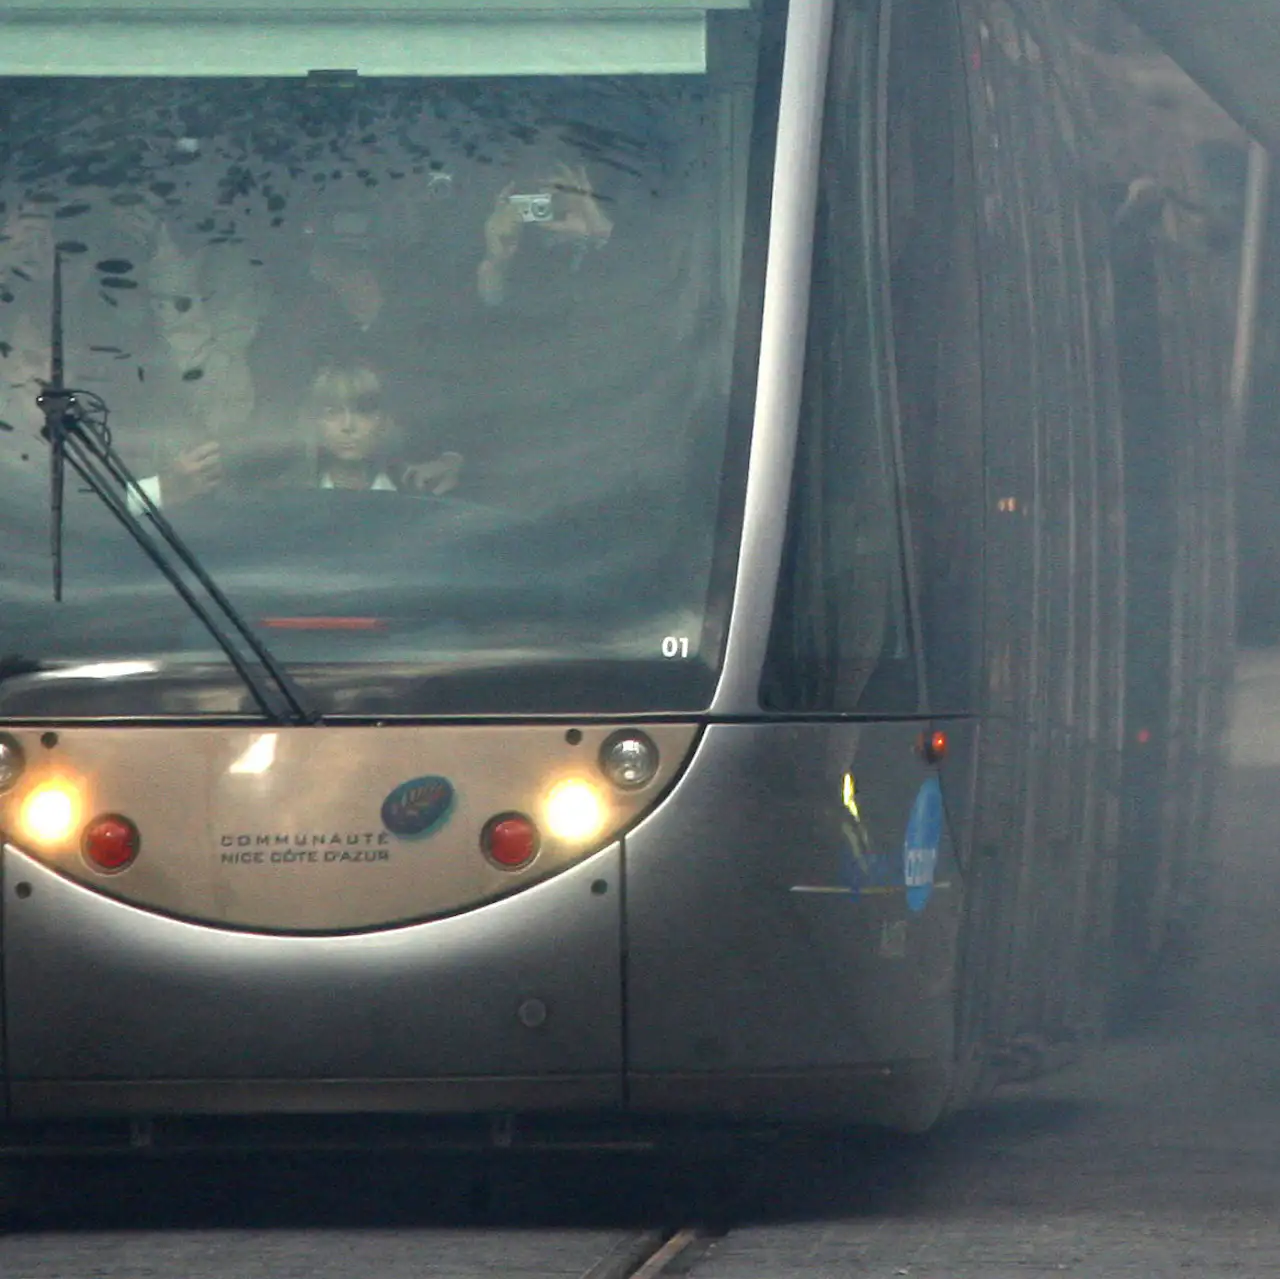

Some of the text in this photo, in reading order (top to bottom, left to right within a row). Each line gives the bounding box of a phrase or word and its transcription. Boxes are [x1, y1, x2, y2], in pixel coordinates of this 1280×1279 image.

[661, 636, 690, 658] 01
[220, 831, 391, 848] COMMUNAUTÉ
[220, 847, 391, 864] NICE CÔTE D'AZUR
